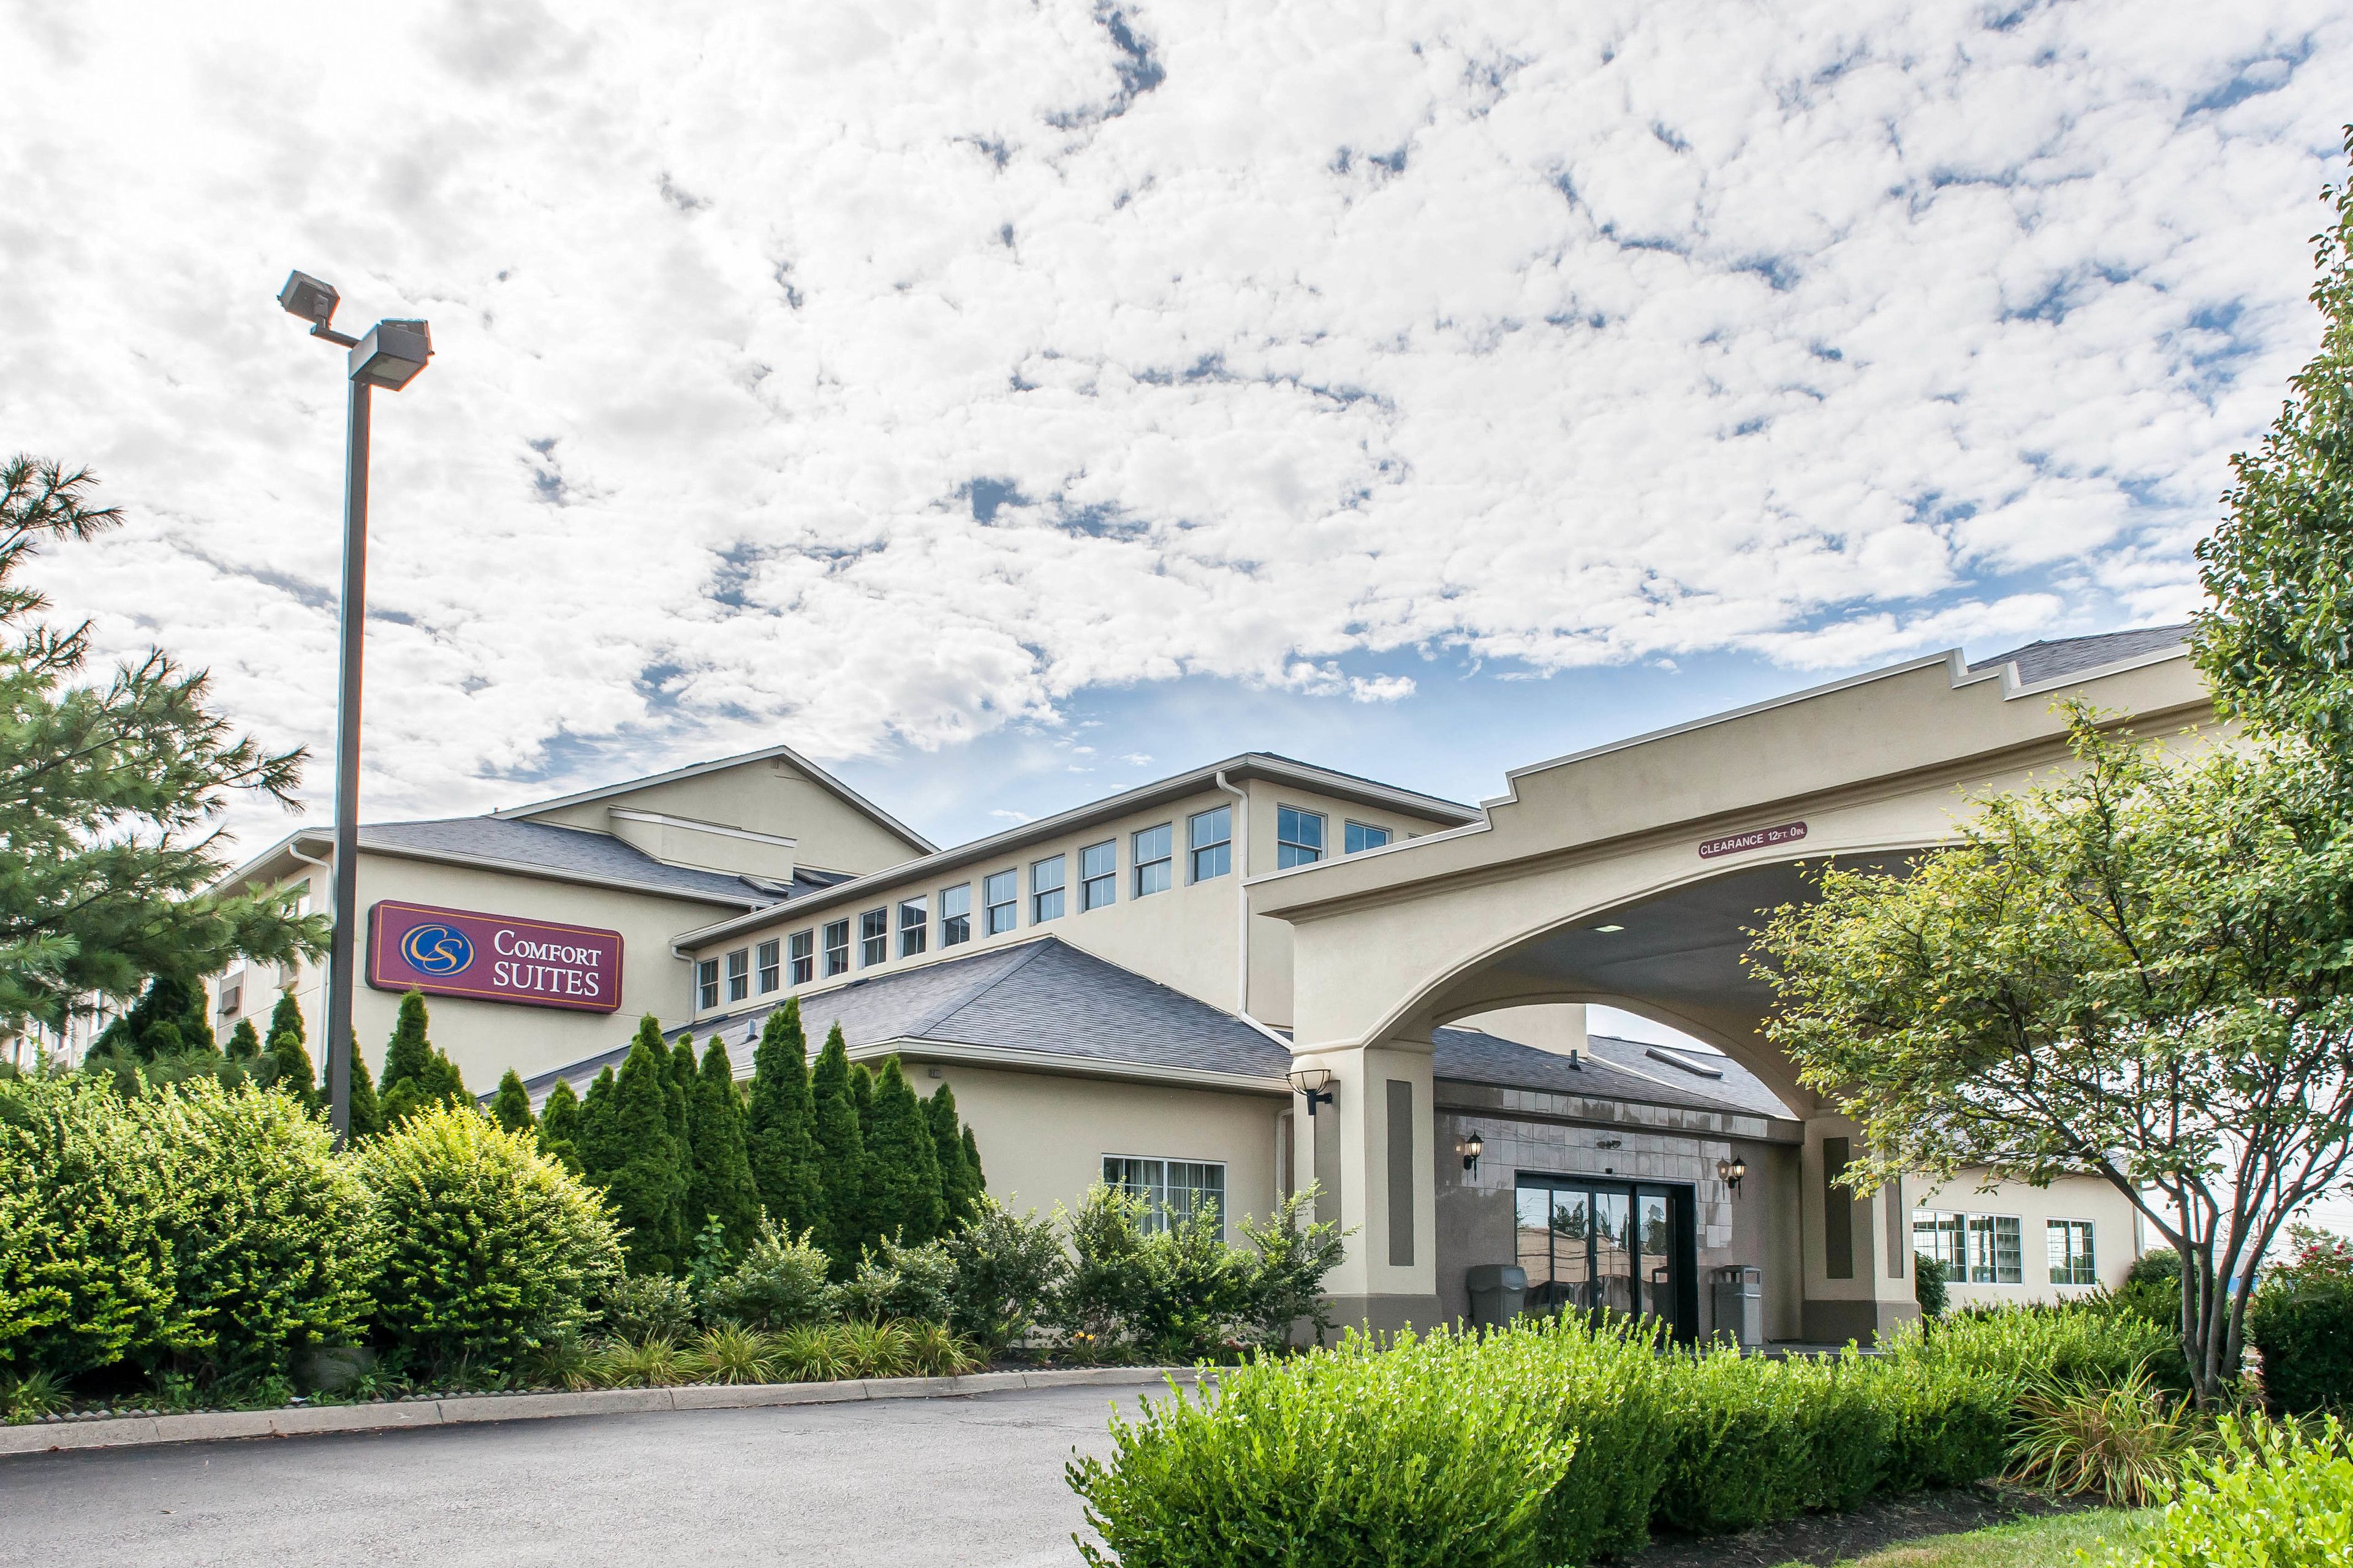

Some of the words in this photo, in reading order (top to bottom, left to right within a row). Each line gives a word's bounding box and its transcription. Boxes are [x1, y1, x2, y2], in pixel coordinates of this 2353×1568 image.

[1700, 833, 1764, 855] CLEARANCE
[493, 929, 601, 967] COMFORT
[493, 961, 600, 996] SUITES
